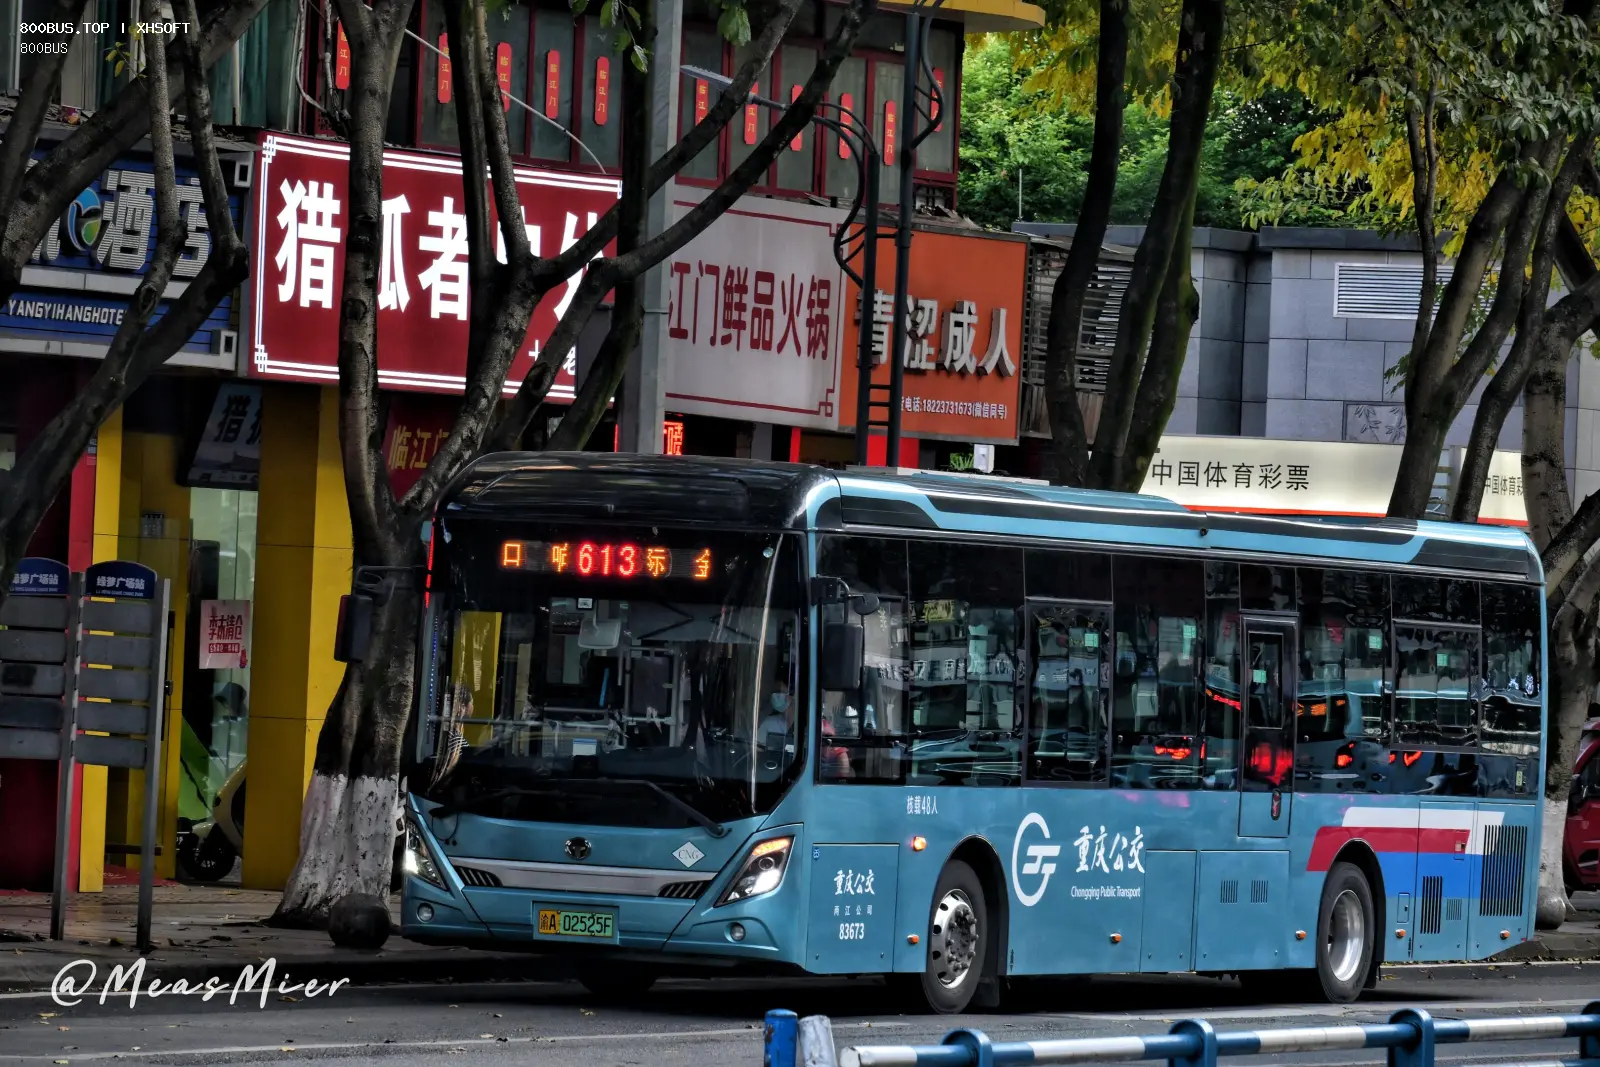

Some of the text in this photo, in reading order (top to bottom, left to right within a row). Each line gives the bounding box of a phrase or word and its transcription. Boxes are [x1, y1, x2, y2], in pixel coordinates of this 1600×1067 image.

[548, 63, 558, 107] 临江门
[597, 69, 607, 113] 临江门
[8, 299, 128, 325] YANGYIHANGHOTE
[1150, 459, 1311, 492] 中国体育彩票
[578, 544, 636, 575] 613
[906, 795, 938, 815] 核载48人
[678, 849, 699, 860] CNG
[1073, 825, 1145, 874] 重庆公交
[833, 869, 875, 896] 重庆公交
[1071, 886, 1141, 900] Chongqing Public Transport
[833, 904, 873, 917] 两江公司
[839, 923, 865, 941] 83673
